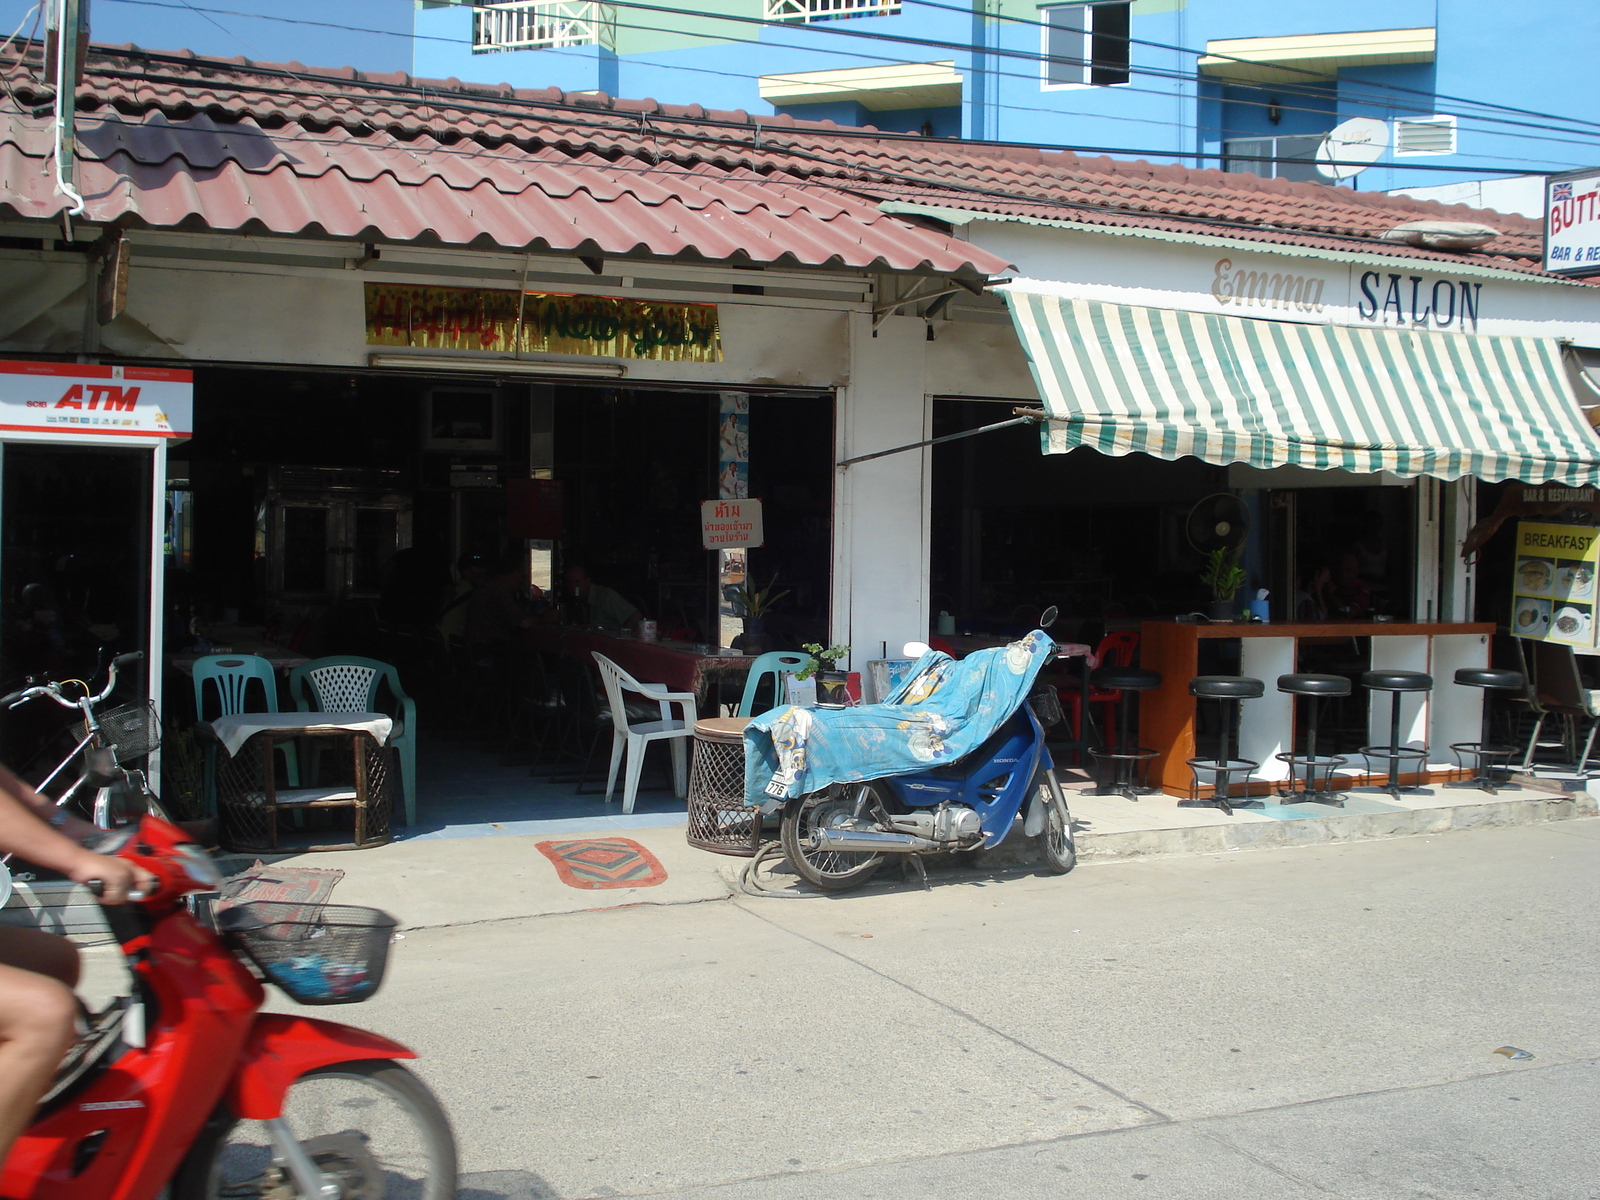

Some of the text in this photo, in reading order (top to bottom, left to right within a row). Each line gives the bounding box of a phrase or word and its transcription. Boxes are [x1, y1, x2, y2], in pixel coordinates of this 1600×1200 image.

[1551, 190, 1600, 237] BUTT
[1551, 245, 1572, 261] BAR
[1575, 246, 1583, 262] &
[1211, 257, 1483, 333] Emma SALON
[375, 294, 500, 346] Happy
[545, 302, 621, 341] New
[53, 384, 141, 412] ATM
[155, 412, 168, 422] 24
[1523, 488, 1594, 502] BAR & RESTAURANT
[715, 501, 740, 518] ห้าม
[1524, 533, 1592, 551] BREAKFAST
[767, 782, 785, 796] 776
